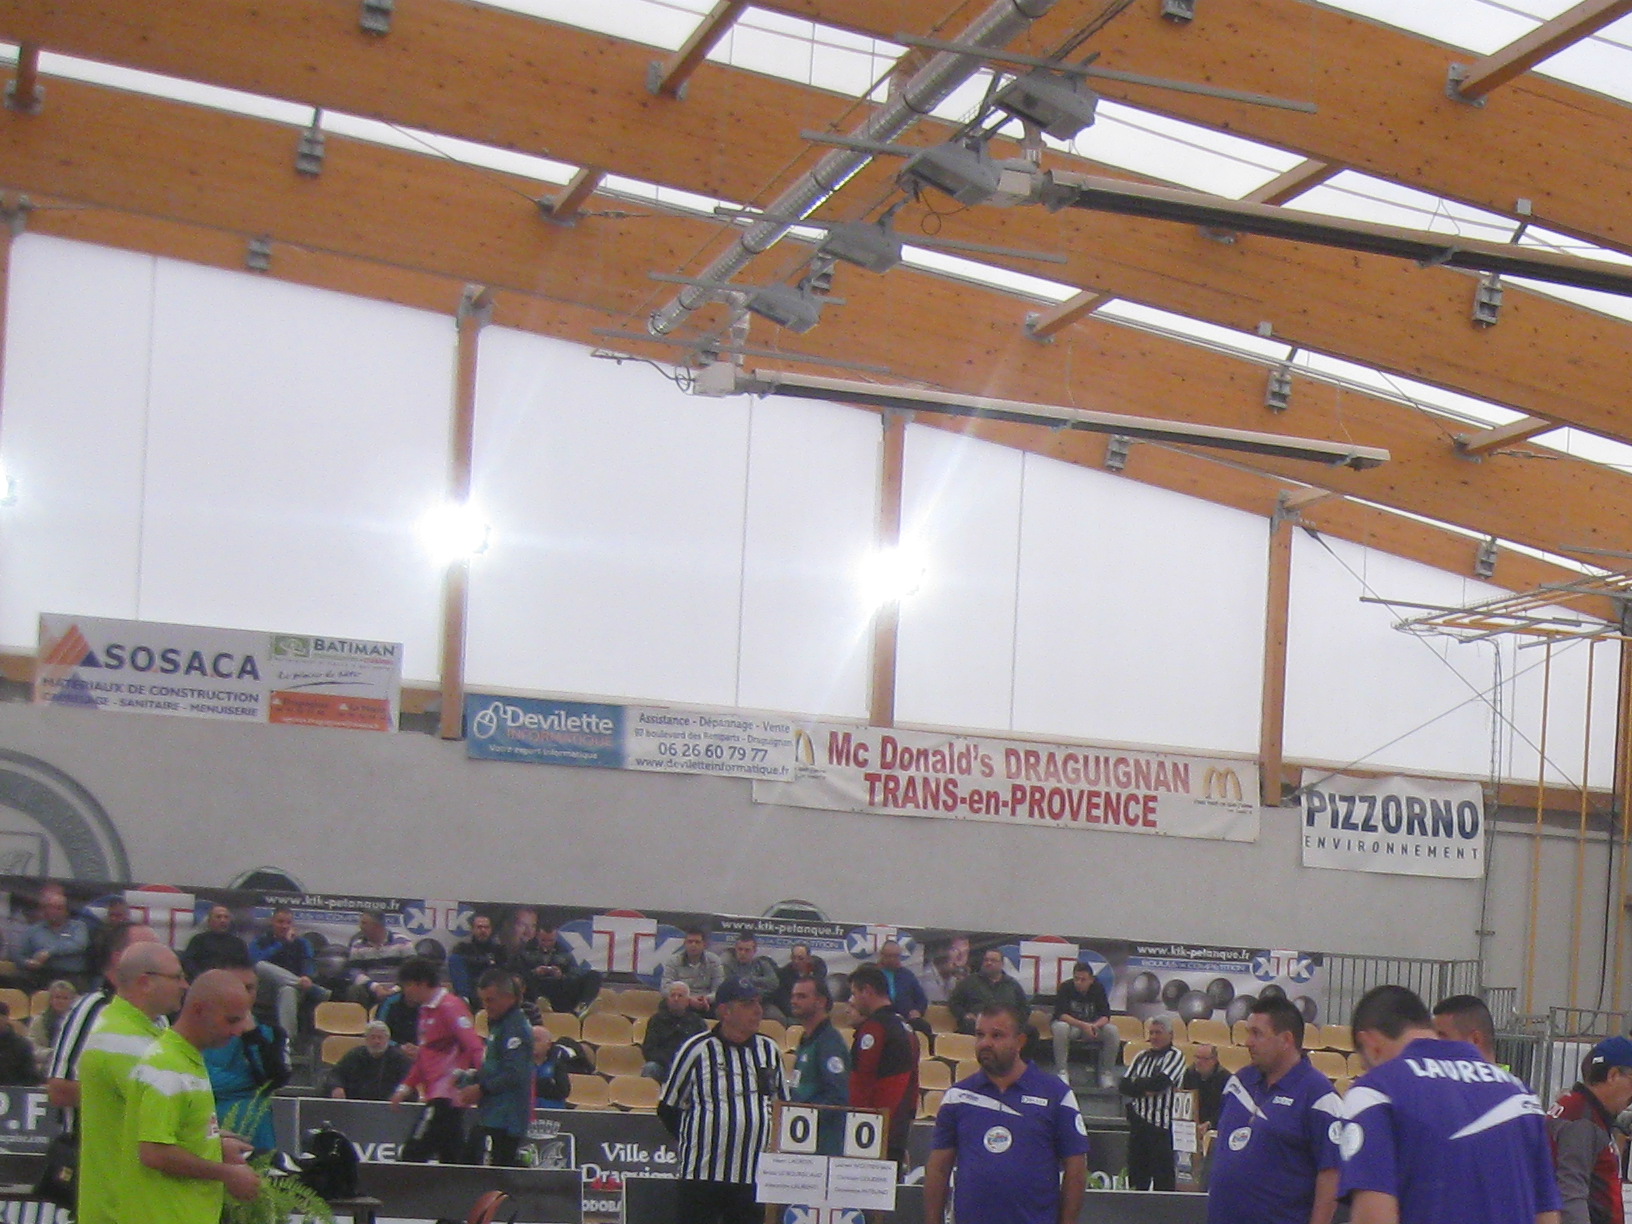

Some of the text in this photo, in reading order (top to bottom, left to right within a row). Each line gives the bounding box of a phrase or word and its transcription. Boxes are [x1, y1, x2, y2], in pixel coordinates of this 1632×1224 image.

[313, 638, 395, 657] BATIMAN
[150, 686, 260, 703] CONSTRUCTION
[506, 706, 614, 735] Devilette
[639, 712, 695, 727] Assistance
[763, 722, 791, 734] Vente
[658, 742, 768, 763] 06 26 60 79 77
[828, 730, 1190, 794] Mc Donald's DRAGUIGNAN
[864, 772, 1158, 828] TRANS-en-PROVENCE
[1305, 789, 1479, 840] PIZZORNO
[1304, 835, 1478, 859] ENVIRONNEMENT
[721, 920, 845, 936] www.ktk-petanque.fr
[789, 1115, 875, 1149] 0 0
[601, 1142, 677, 1164] Ville de
